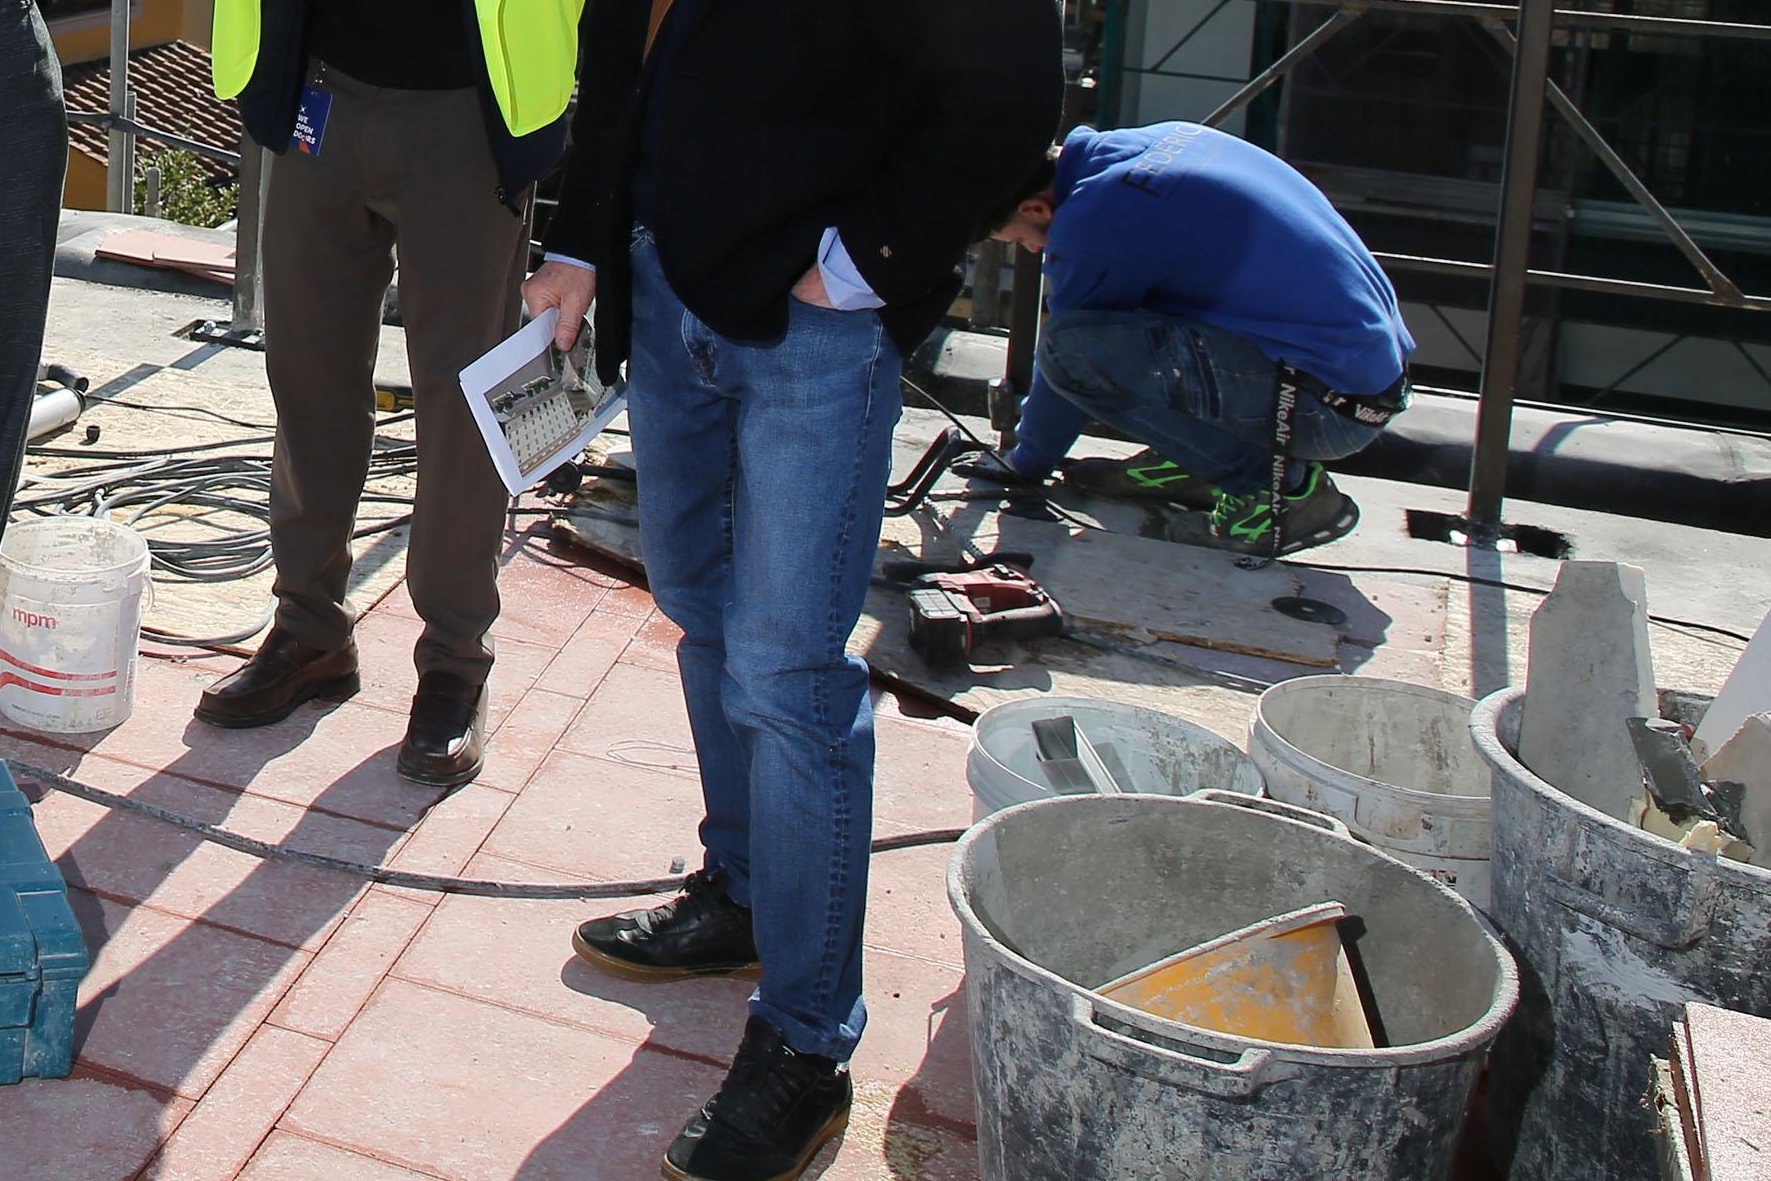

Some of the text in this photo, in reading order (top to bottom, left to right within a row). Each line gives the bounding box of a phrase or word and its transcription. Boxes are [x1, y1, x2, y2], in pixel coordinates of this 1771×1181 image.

[298, 114, 308, 123] WE
[295, 123, 313, 134] OPEN
[1275, 383, 1297, 446] NikeAir
[13, 608, 57, 629] mpm
